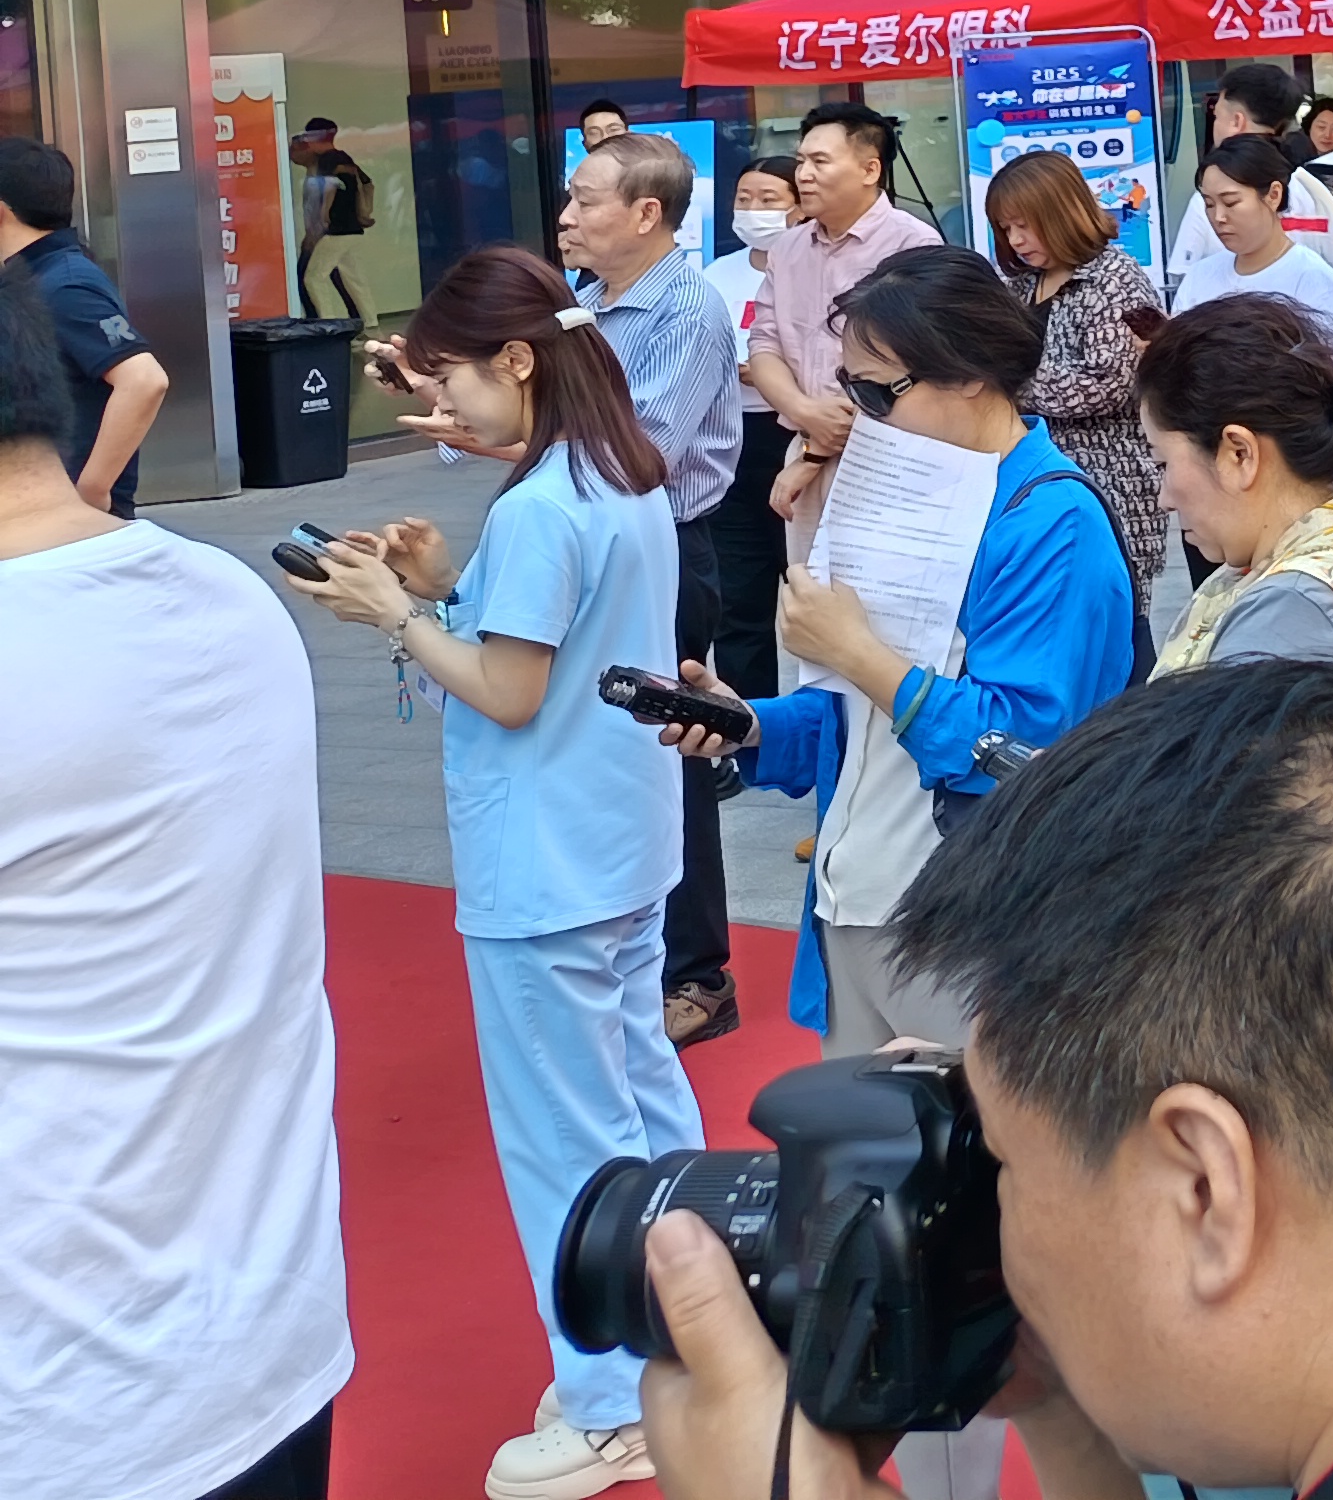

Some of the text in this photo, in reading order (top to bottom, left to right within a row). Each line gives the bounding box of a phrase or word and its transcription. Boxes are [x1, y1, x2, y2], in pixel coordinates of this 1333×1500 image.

[778, 5, 1032, 70] 辽宁爱尔眼科
[1032, 67, 1080, 82] 2025
